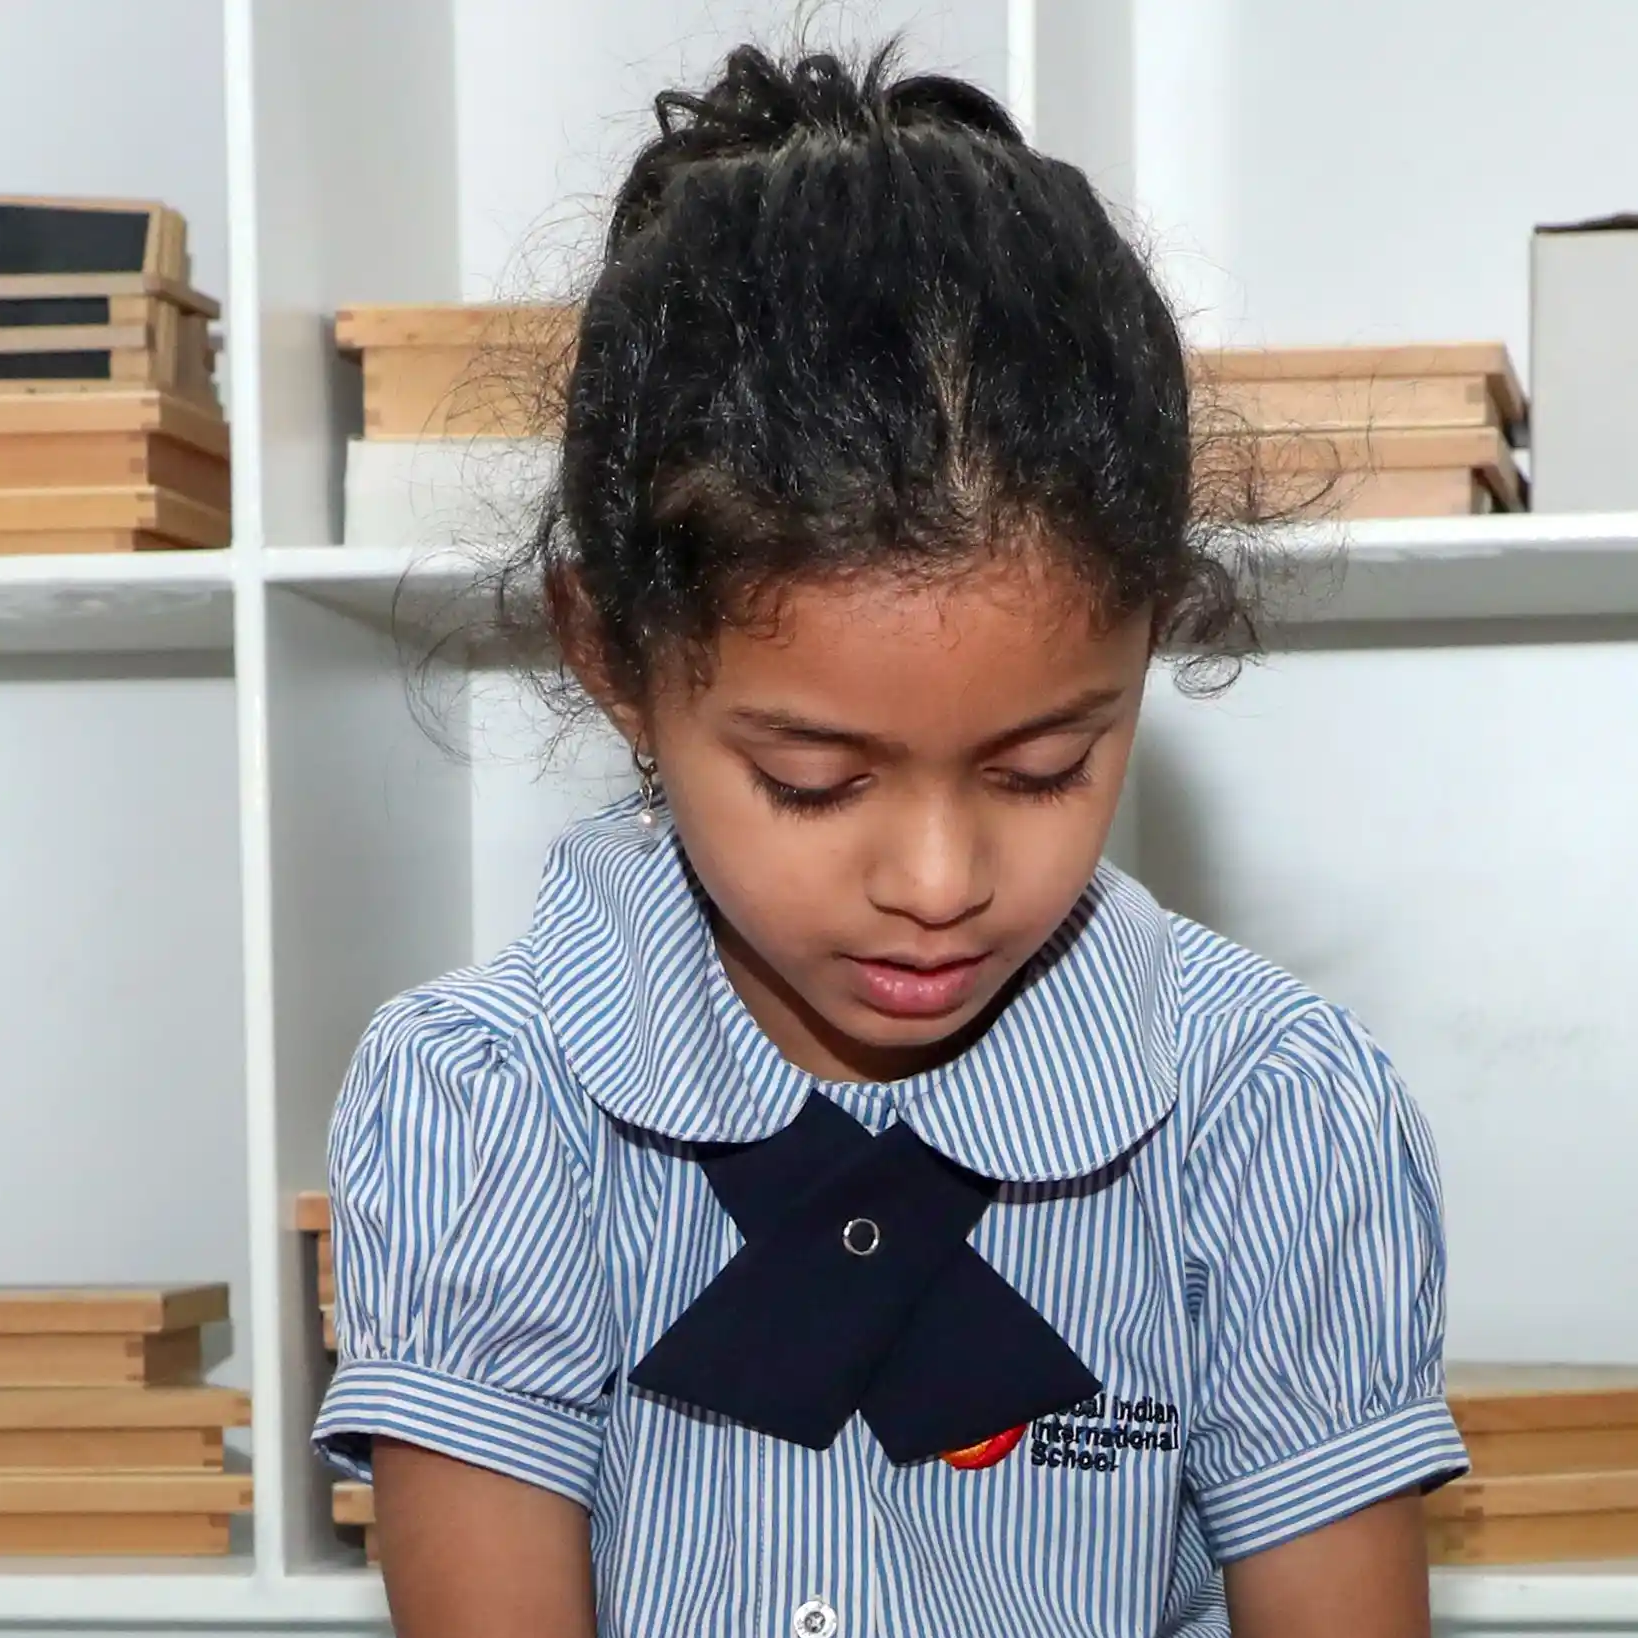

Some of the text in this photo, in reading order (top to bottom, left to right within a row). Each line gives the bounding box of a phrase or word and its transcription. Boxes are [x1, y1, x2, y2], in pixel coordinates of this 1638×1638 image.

[1112, 1395, 1179, 1425] Indian
[1031, 1417, 1180, 1451] International
[1030, 1440, 1119, 1472] School
